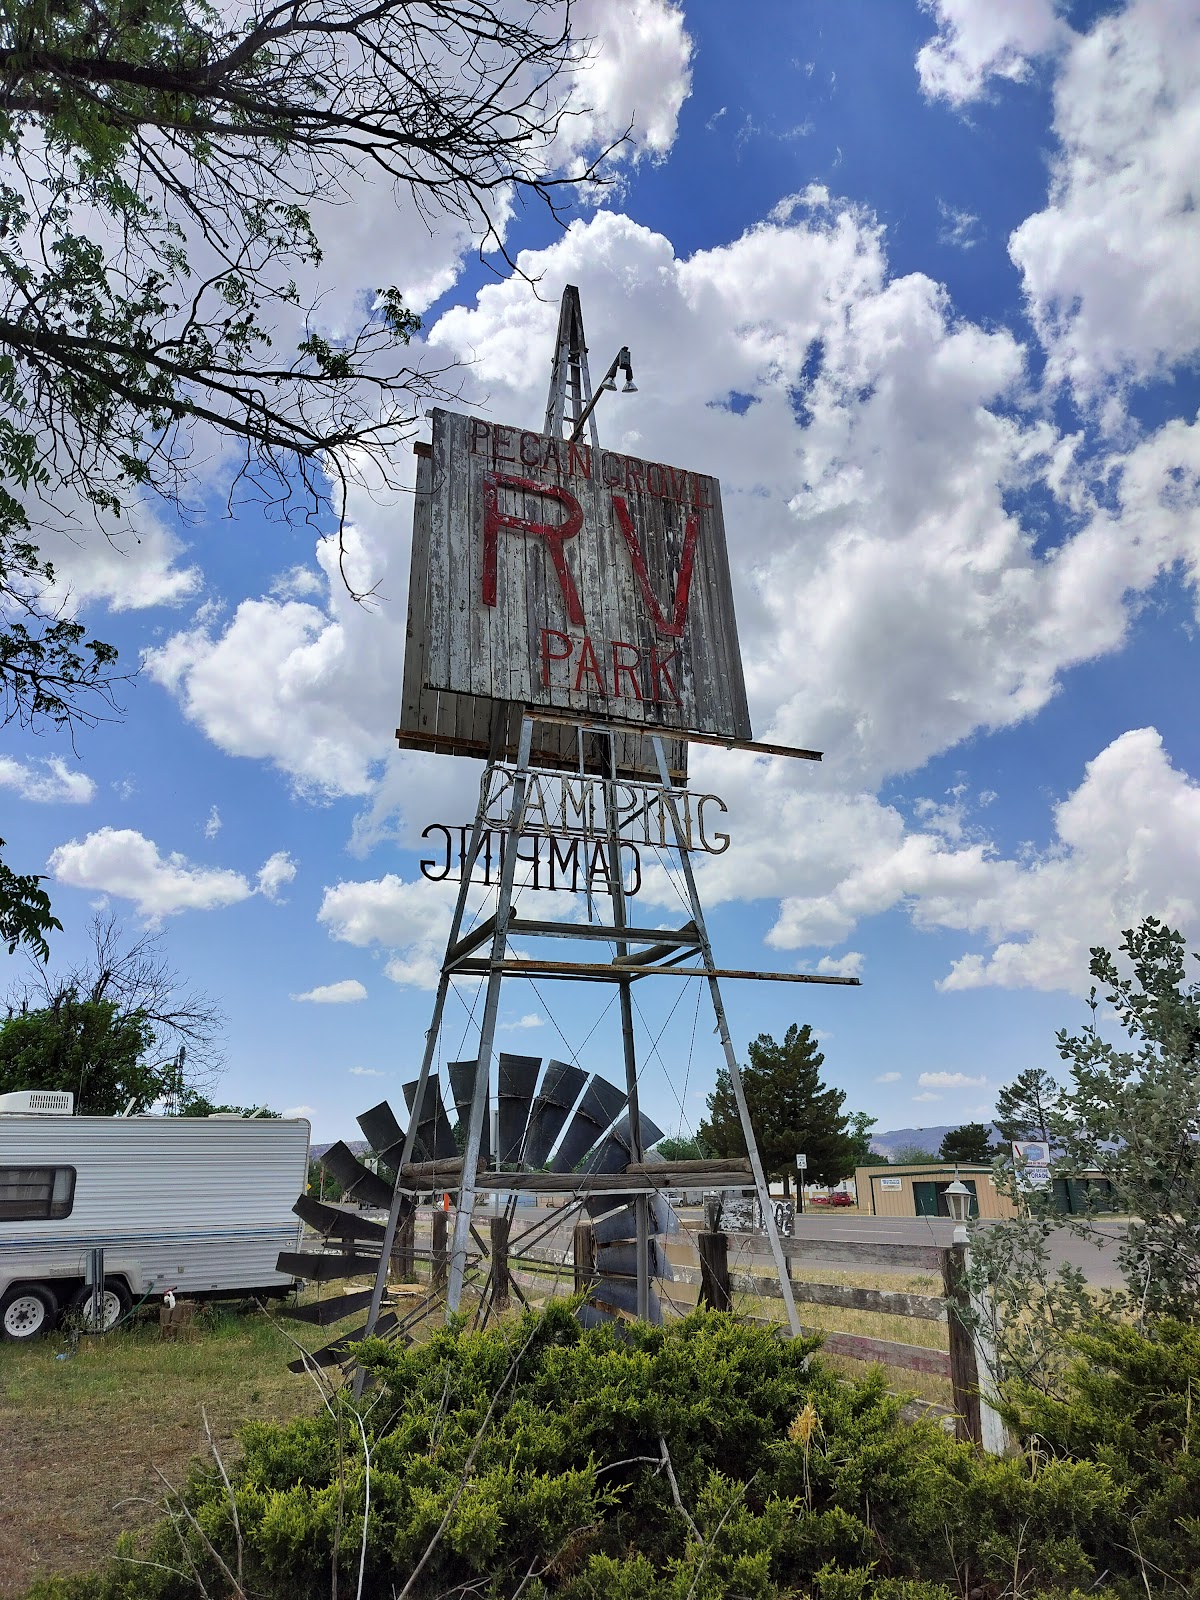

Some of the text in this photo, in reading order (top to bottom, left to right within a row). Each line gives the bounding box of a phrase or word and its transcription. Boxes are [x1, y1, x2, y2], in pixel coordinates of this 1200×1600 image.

[469, 415, 715, 508] PECAN GROVE
[482, 470, 699, 638] RV
[540, 628, 684, 706] PARK
[479, 764, 730, 855] CAMPING
